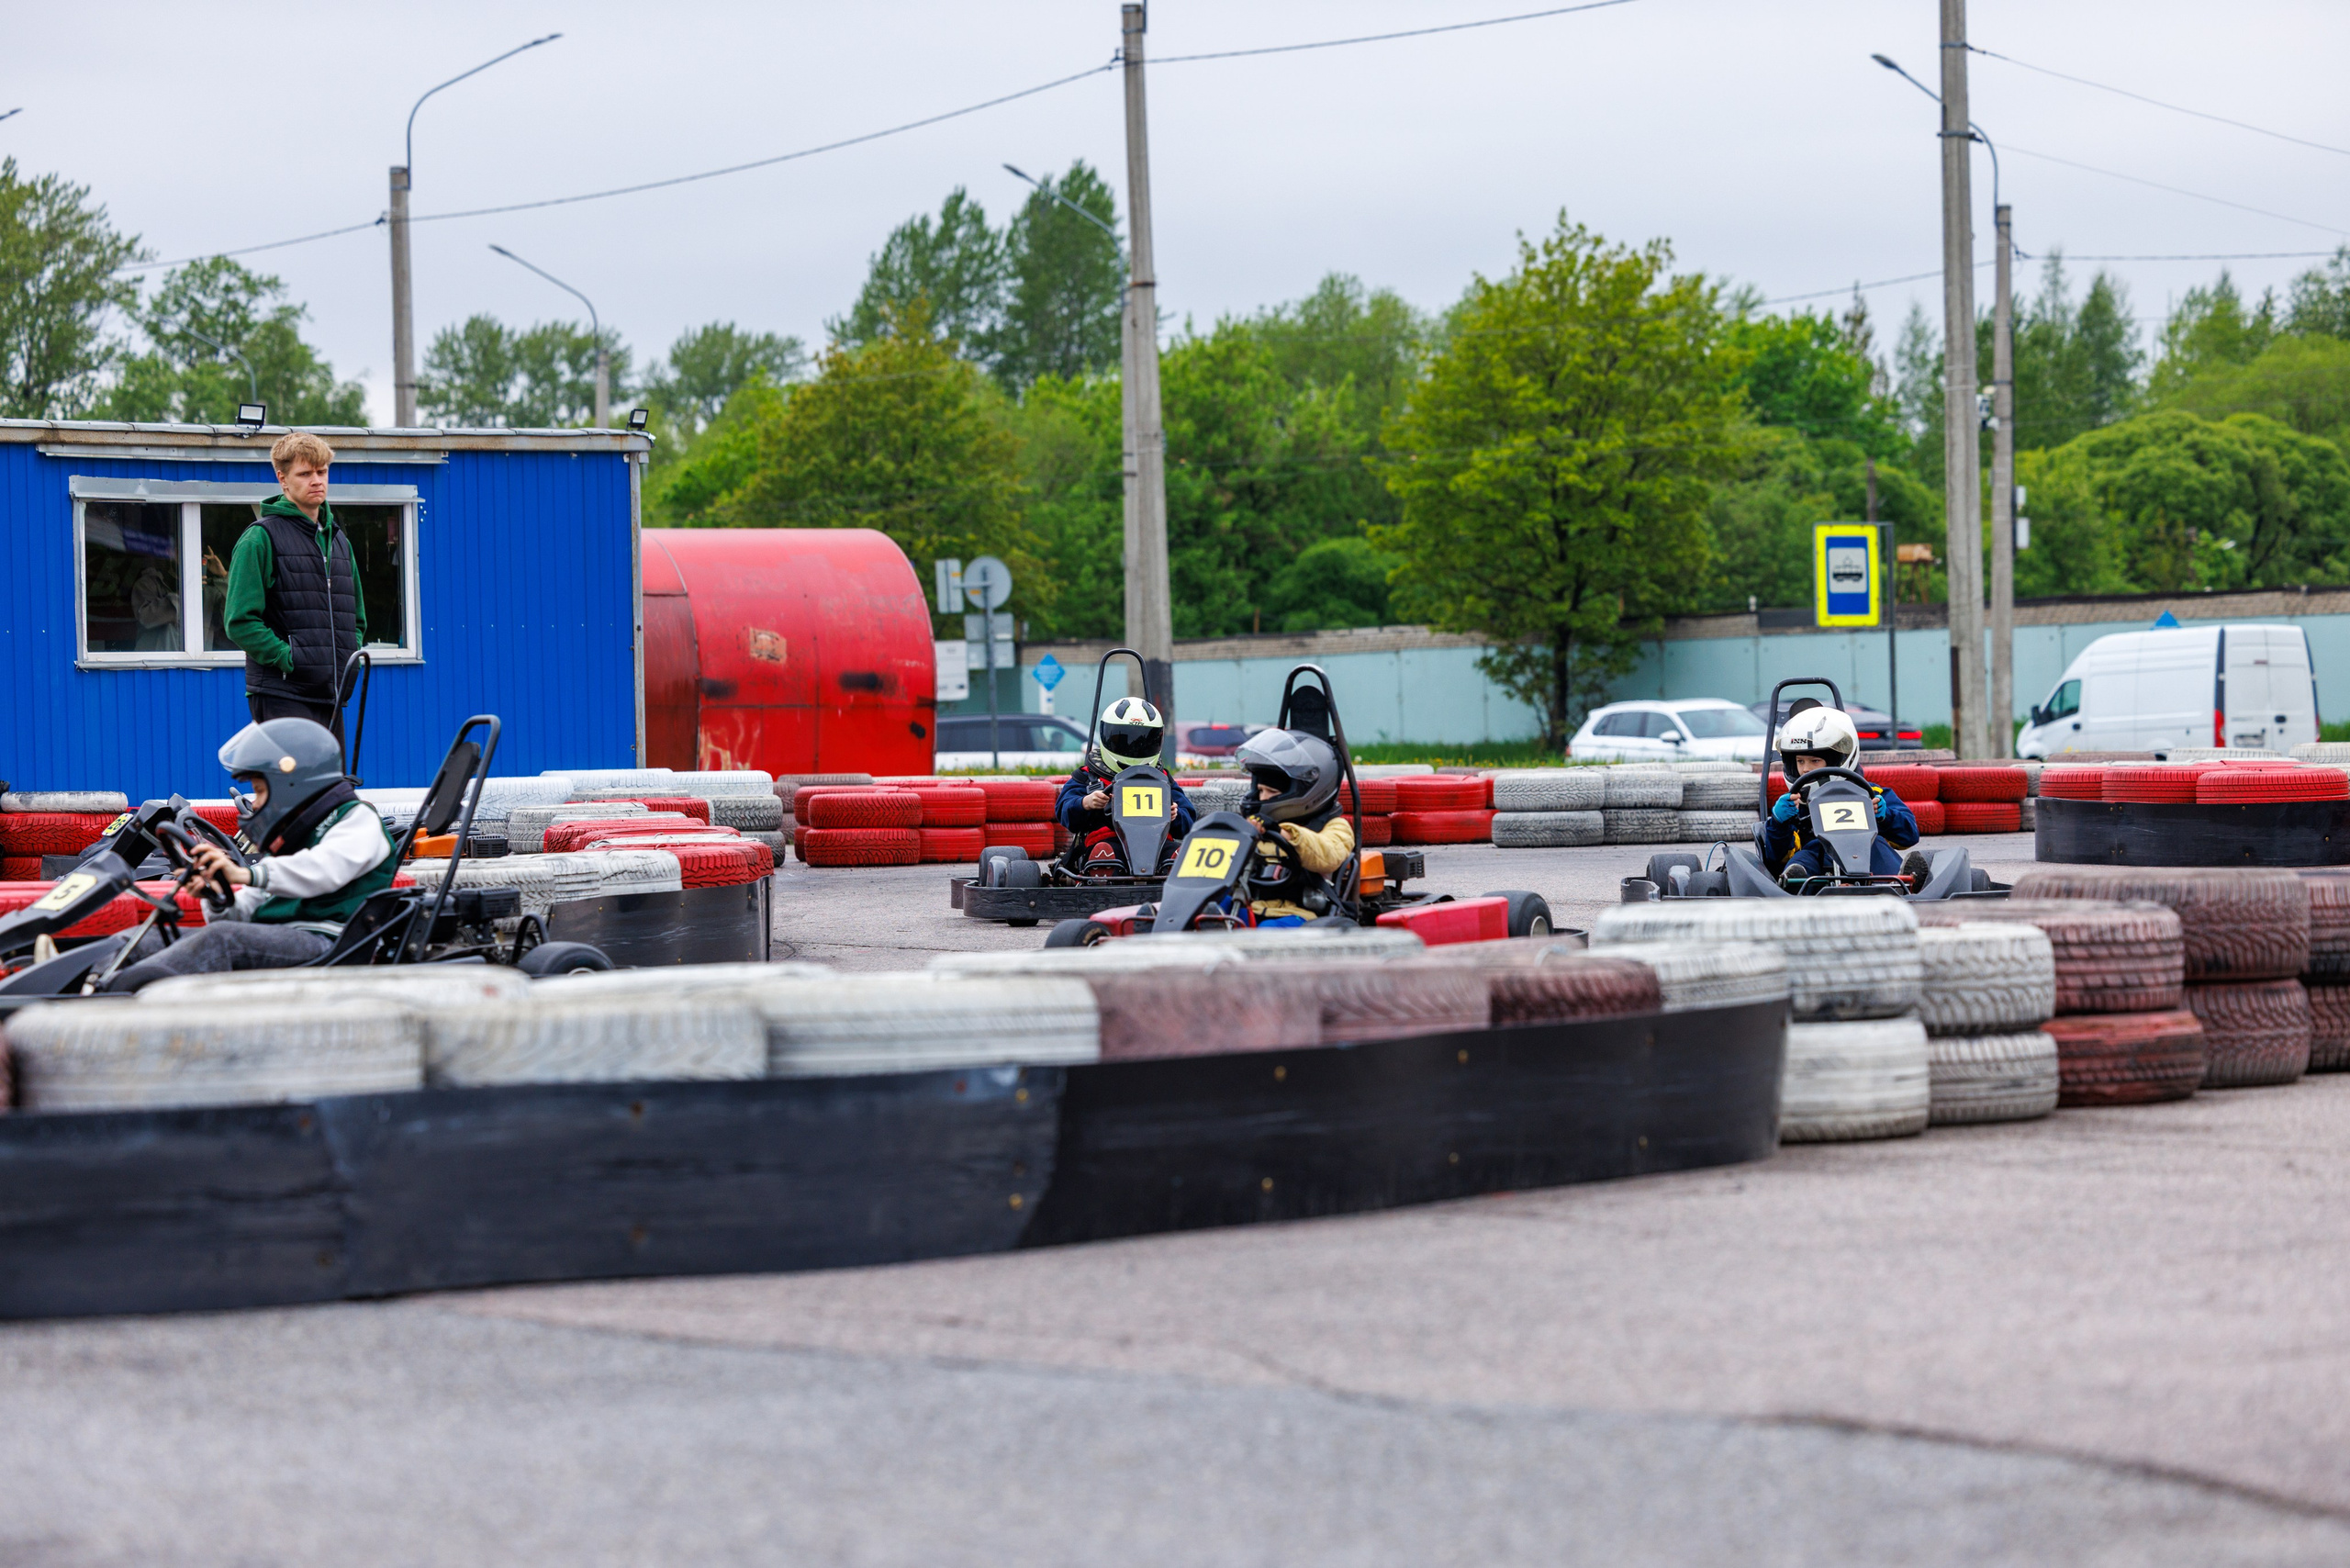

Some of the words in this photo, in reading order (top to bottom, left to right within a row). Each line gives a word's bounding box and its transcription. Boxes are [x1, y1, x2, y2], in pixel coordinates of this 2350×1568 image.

[1133, 794, 1153, 810] 11
[1834, 809, 1855, 823] 2
[1195, 847, 1225, 868] 10
[53, 884, 80, 900] 5
